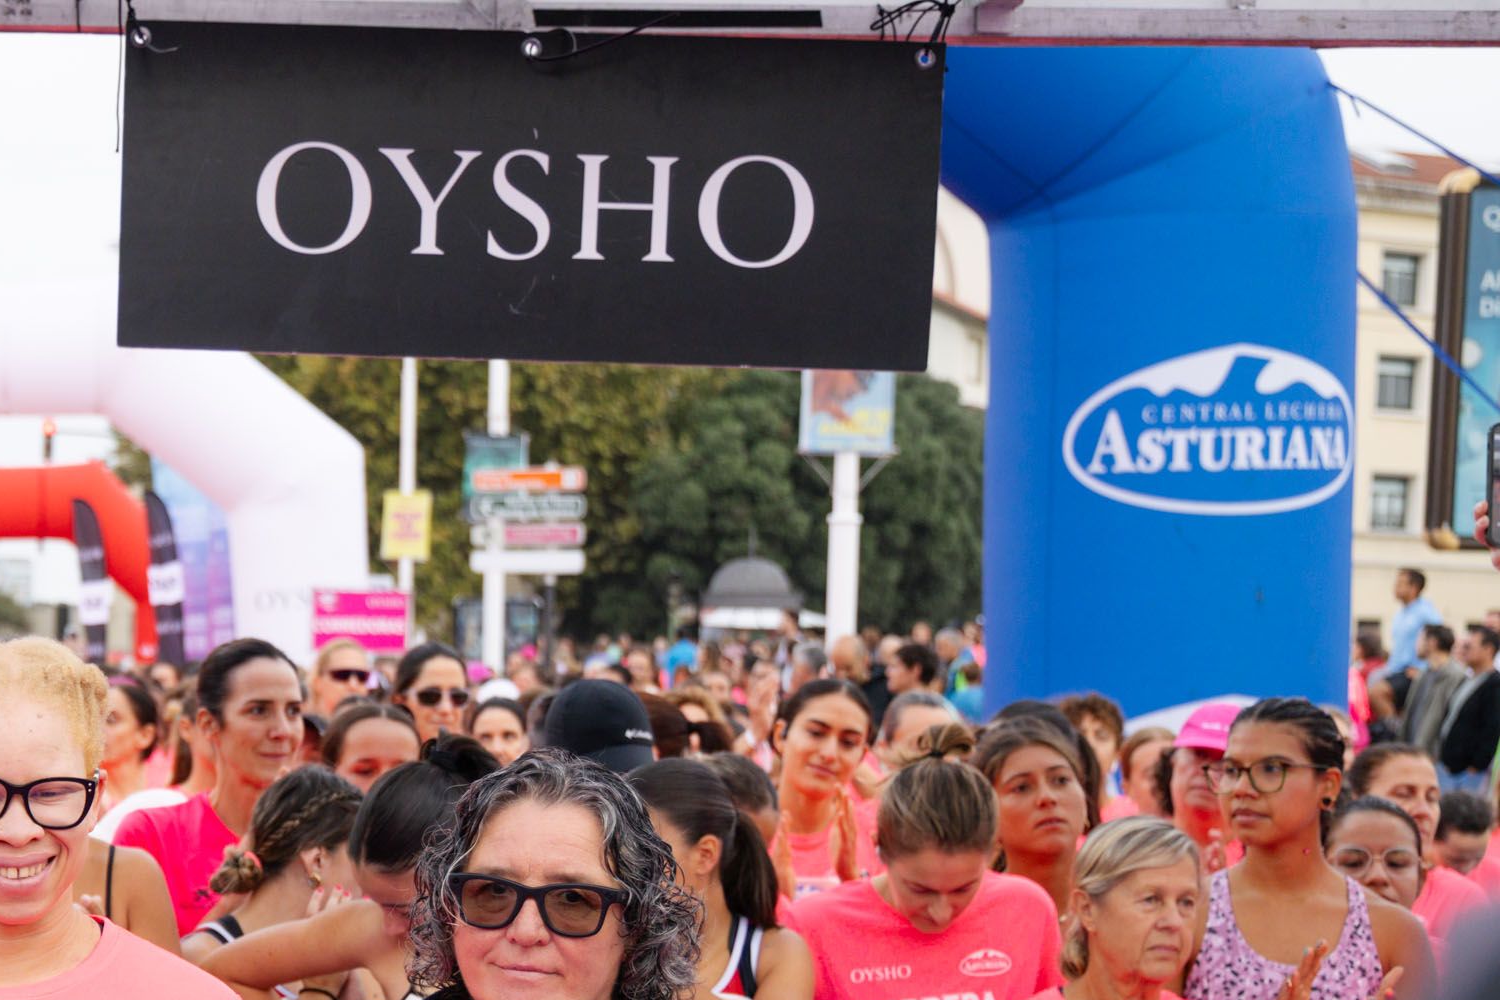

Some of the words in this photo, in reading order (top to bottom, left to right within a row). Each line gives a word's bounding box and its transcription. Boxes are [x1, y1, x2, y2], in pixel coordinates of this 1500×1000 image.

[256, 141, 815, 268] OYSHO
[1141, 400, 1257, 424] CENTRAL
[1086, 408, 1345, 474] ASTURIANA
[850, 965, 912, 984] OYSHO
